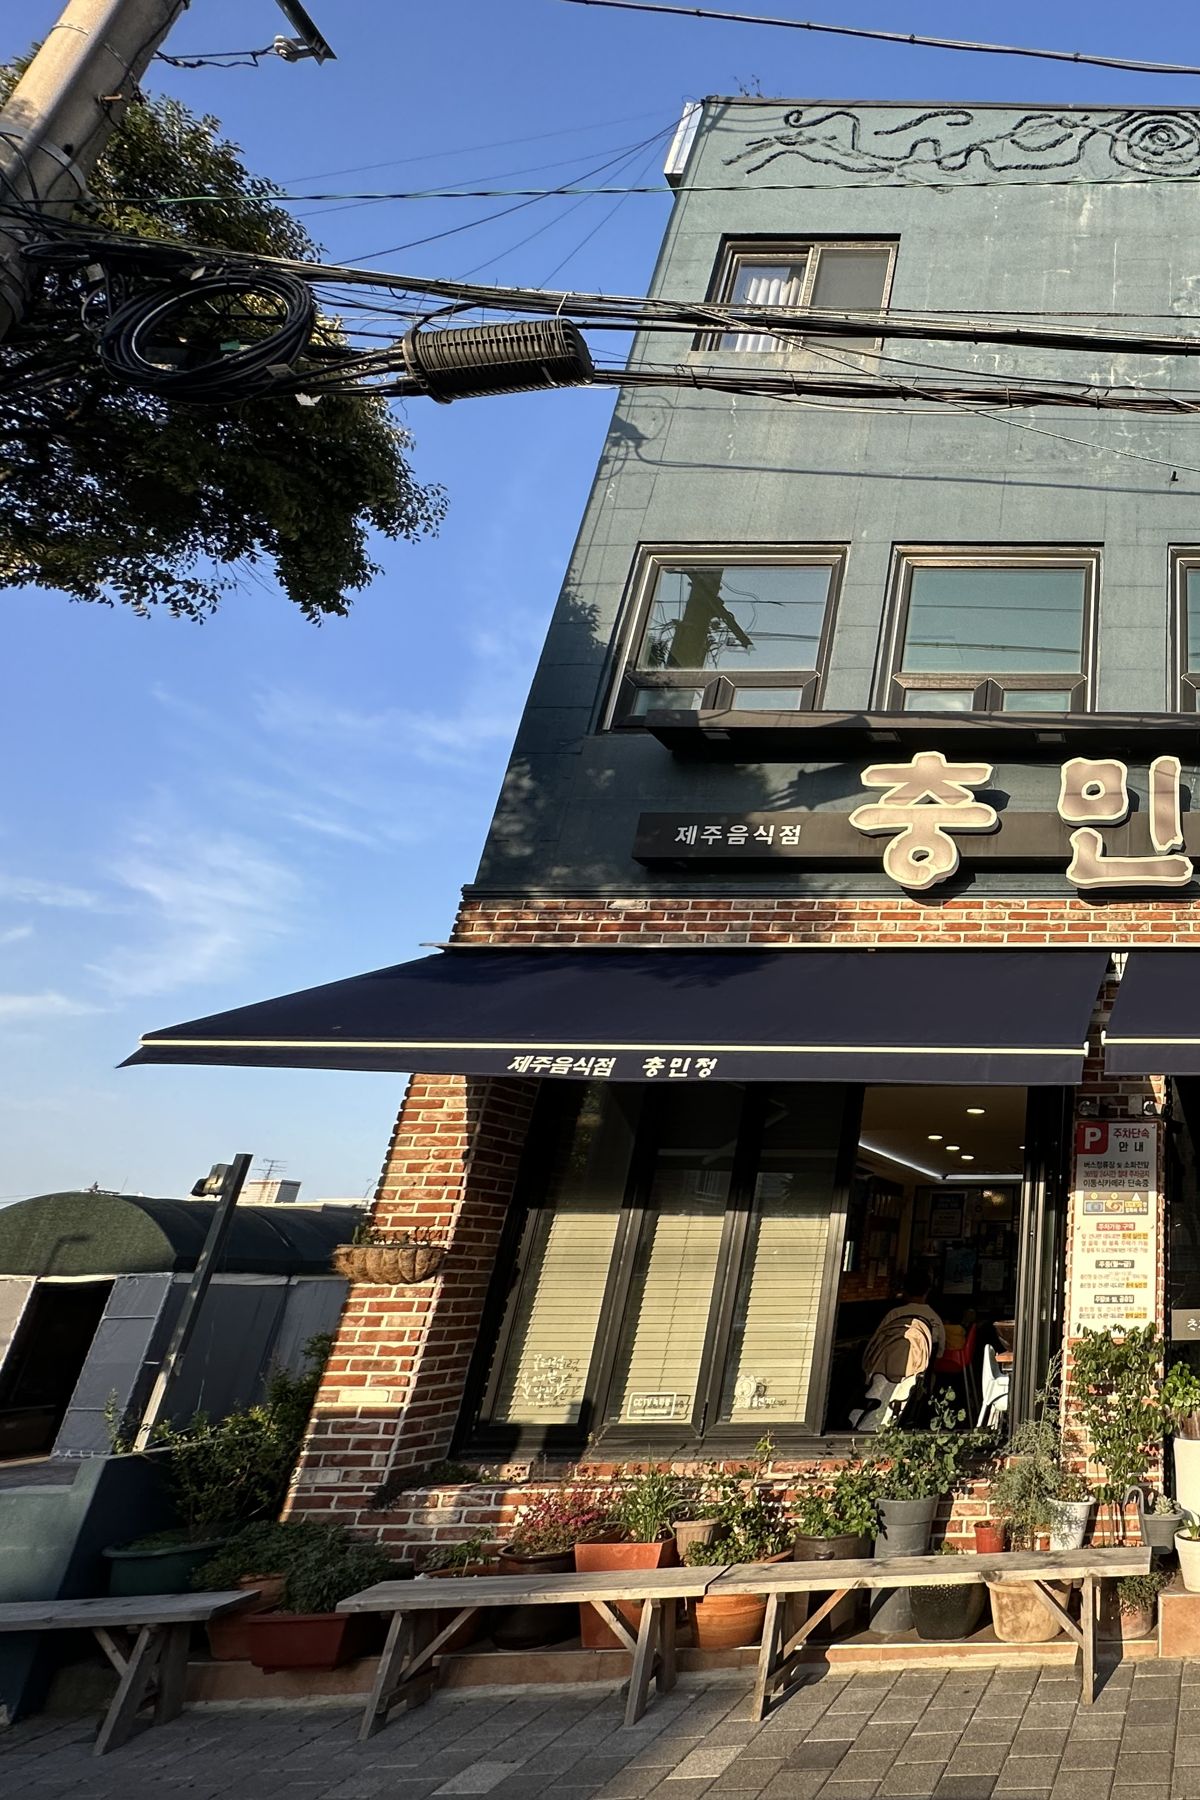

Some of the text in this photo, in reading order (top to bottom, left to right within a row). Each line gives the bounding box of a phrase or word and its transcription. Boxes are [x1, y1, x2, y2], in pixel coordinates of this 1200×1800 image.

[674, 823, 801, 846] 제주음식점
[507, 1055, 718, 1079] 제주음식점 충민정
[1084, 1127, 1102, 1150] P
[1113, 1127, 1150, 1139] 주차단속
[1083, 1179, 1150, 1188] 이동식카메라 단속중
